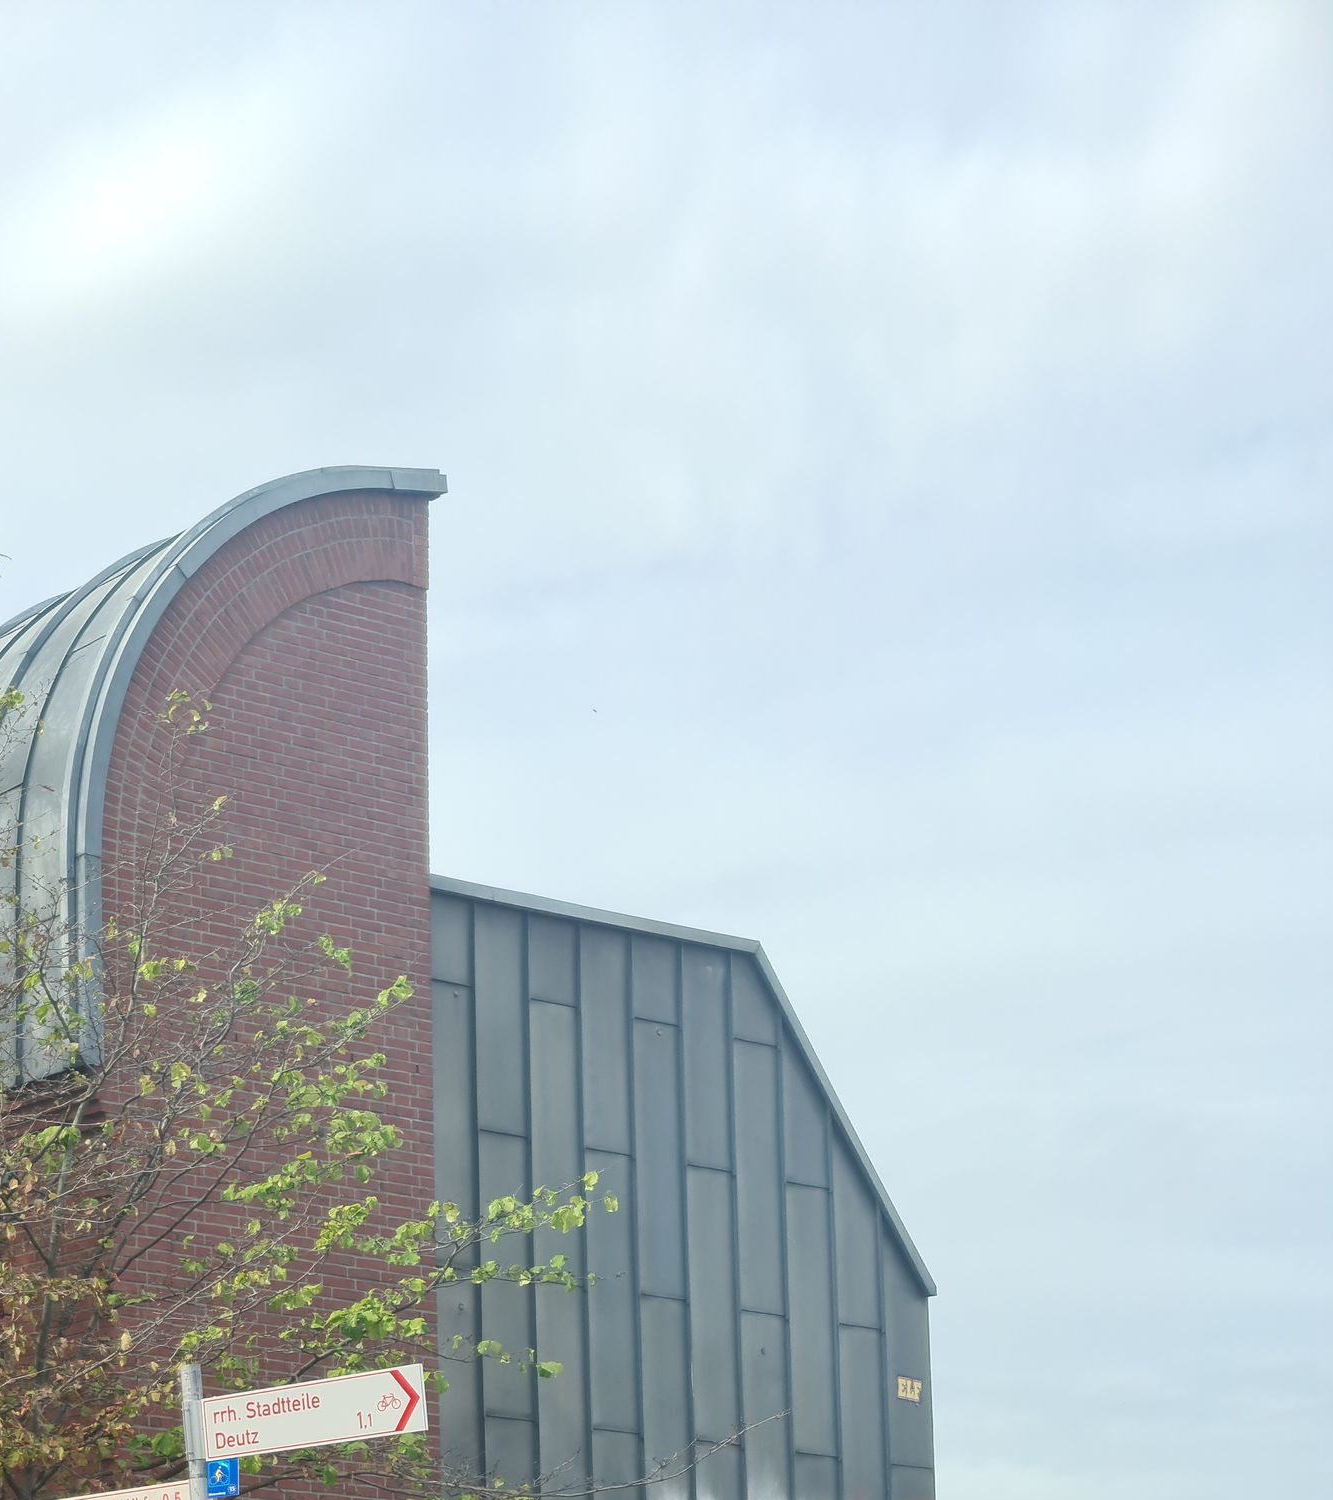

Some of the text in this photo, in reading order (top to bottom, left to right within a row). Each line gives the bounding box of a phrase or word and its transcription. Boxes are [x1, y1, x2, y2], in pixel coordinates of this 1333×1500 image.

[213, 1392, 321, 1424] rrh. Stadtteile
[215, 1430, 259, 1450] Deutz
